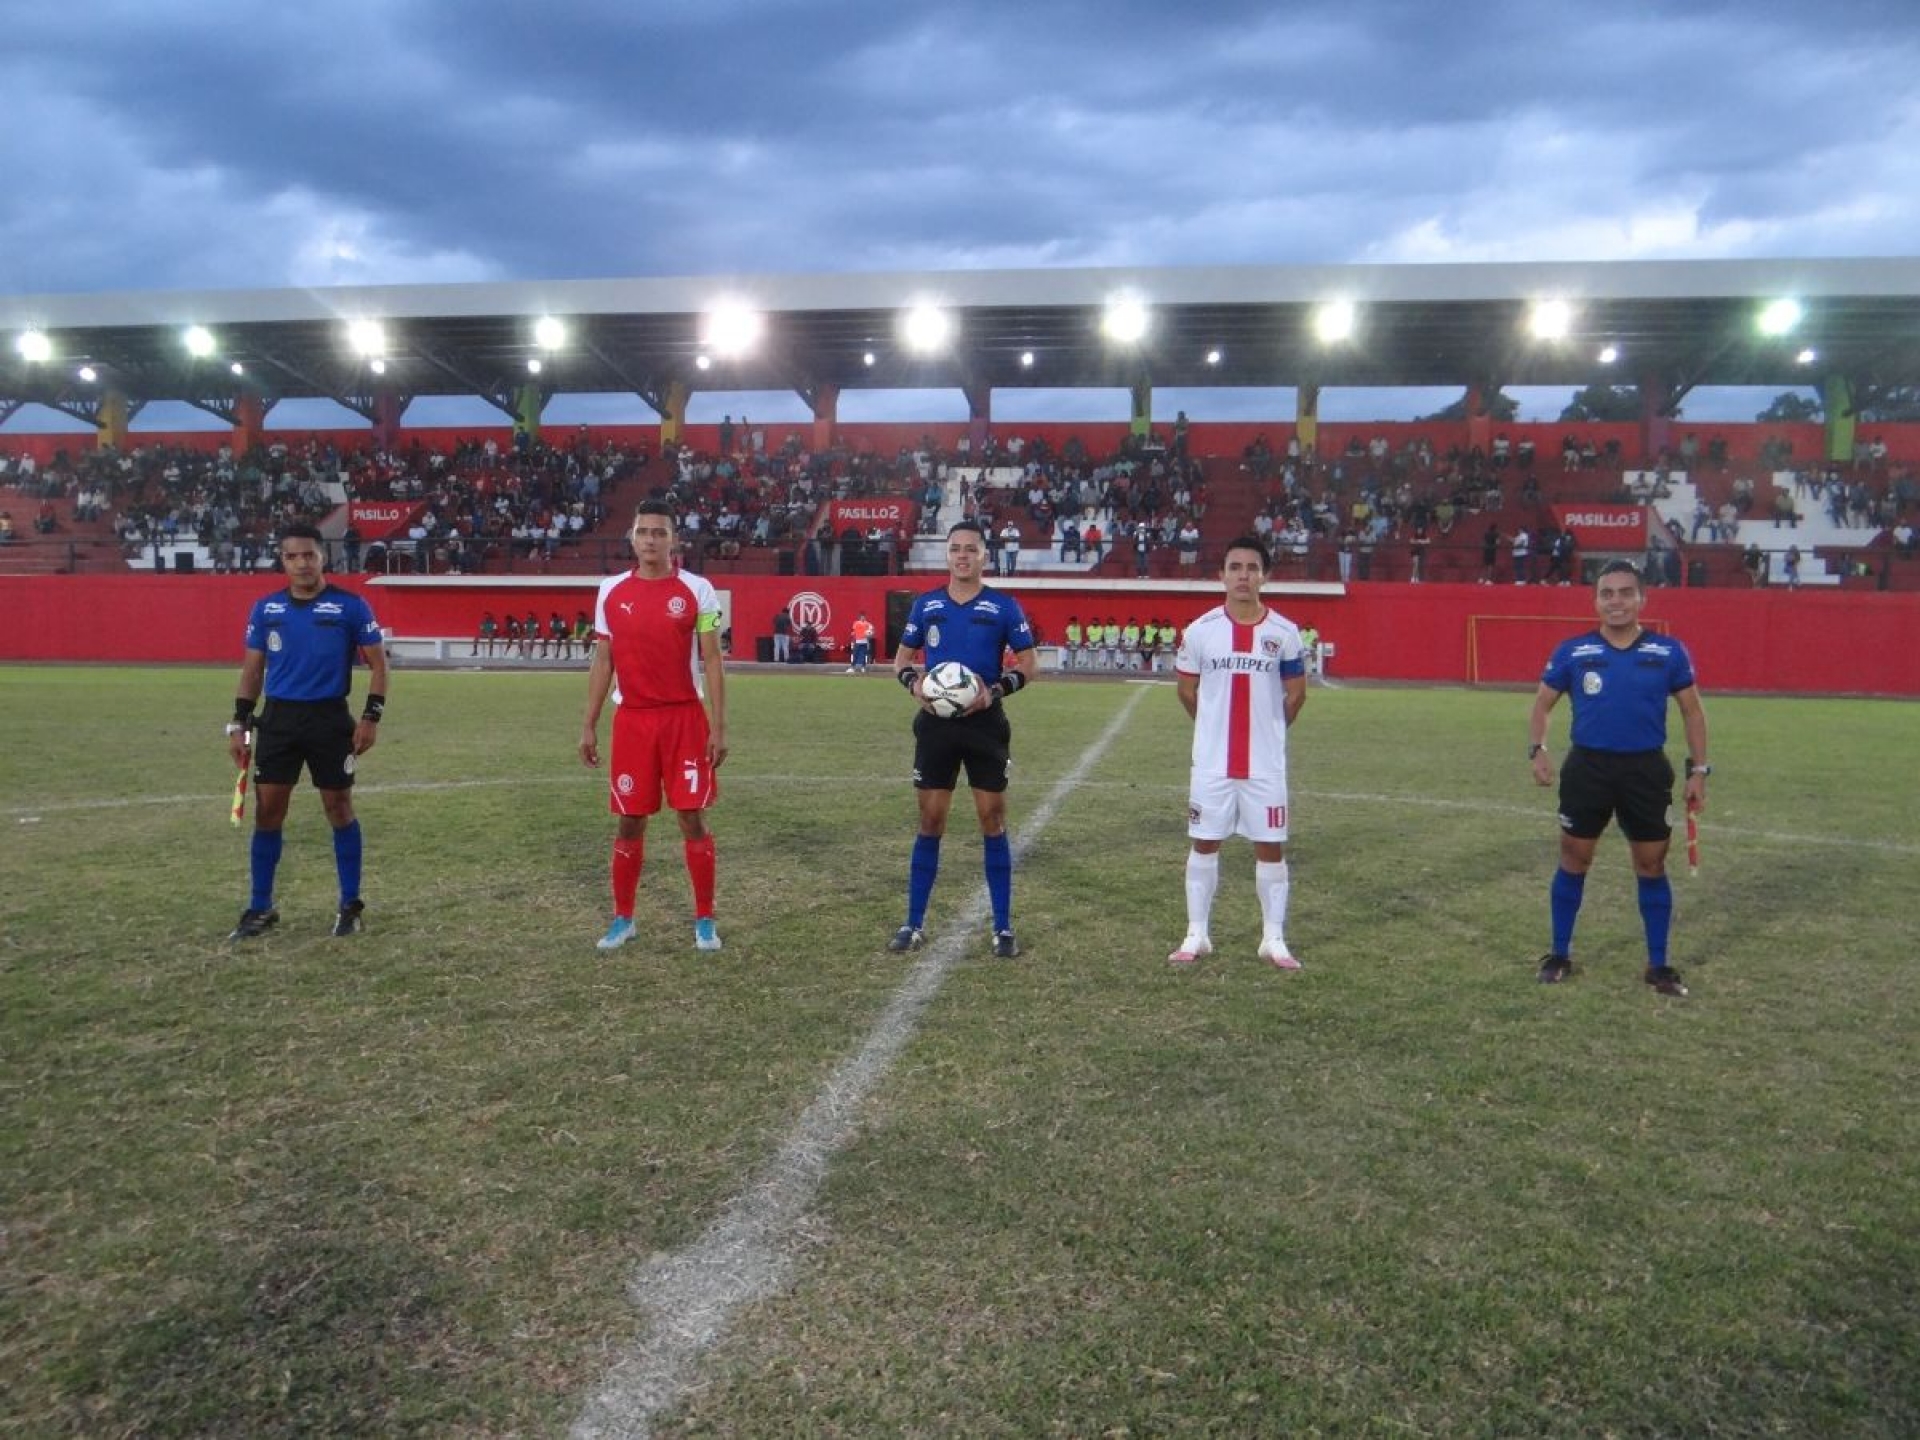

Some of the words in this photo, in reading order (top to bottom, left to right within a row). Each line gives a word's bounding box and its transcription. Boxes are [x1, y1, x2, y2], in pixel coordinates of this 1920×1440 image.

[353, 509, 399, 520] PASILLO
[1212, 657, 1274, 672] YAUTEPEC
[684, 769, 698, 793] 7
[1265, 806, 1286, 828] 10
